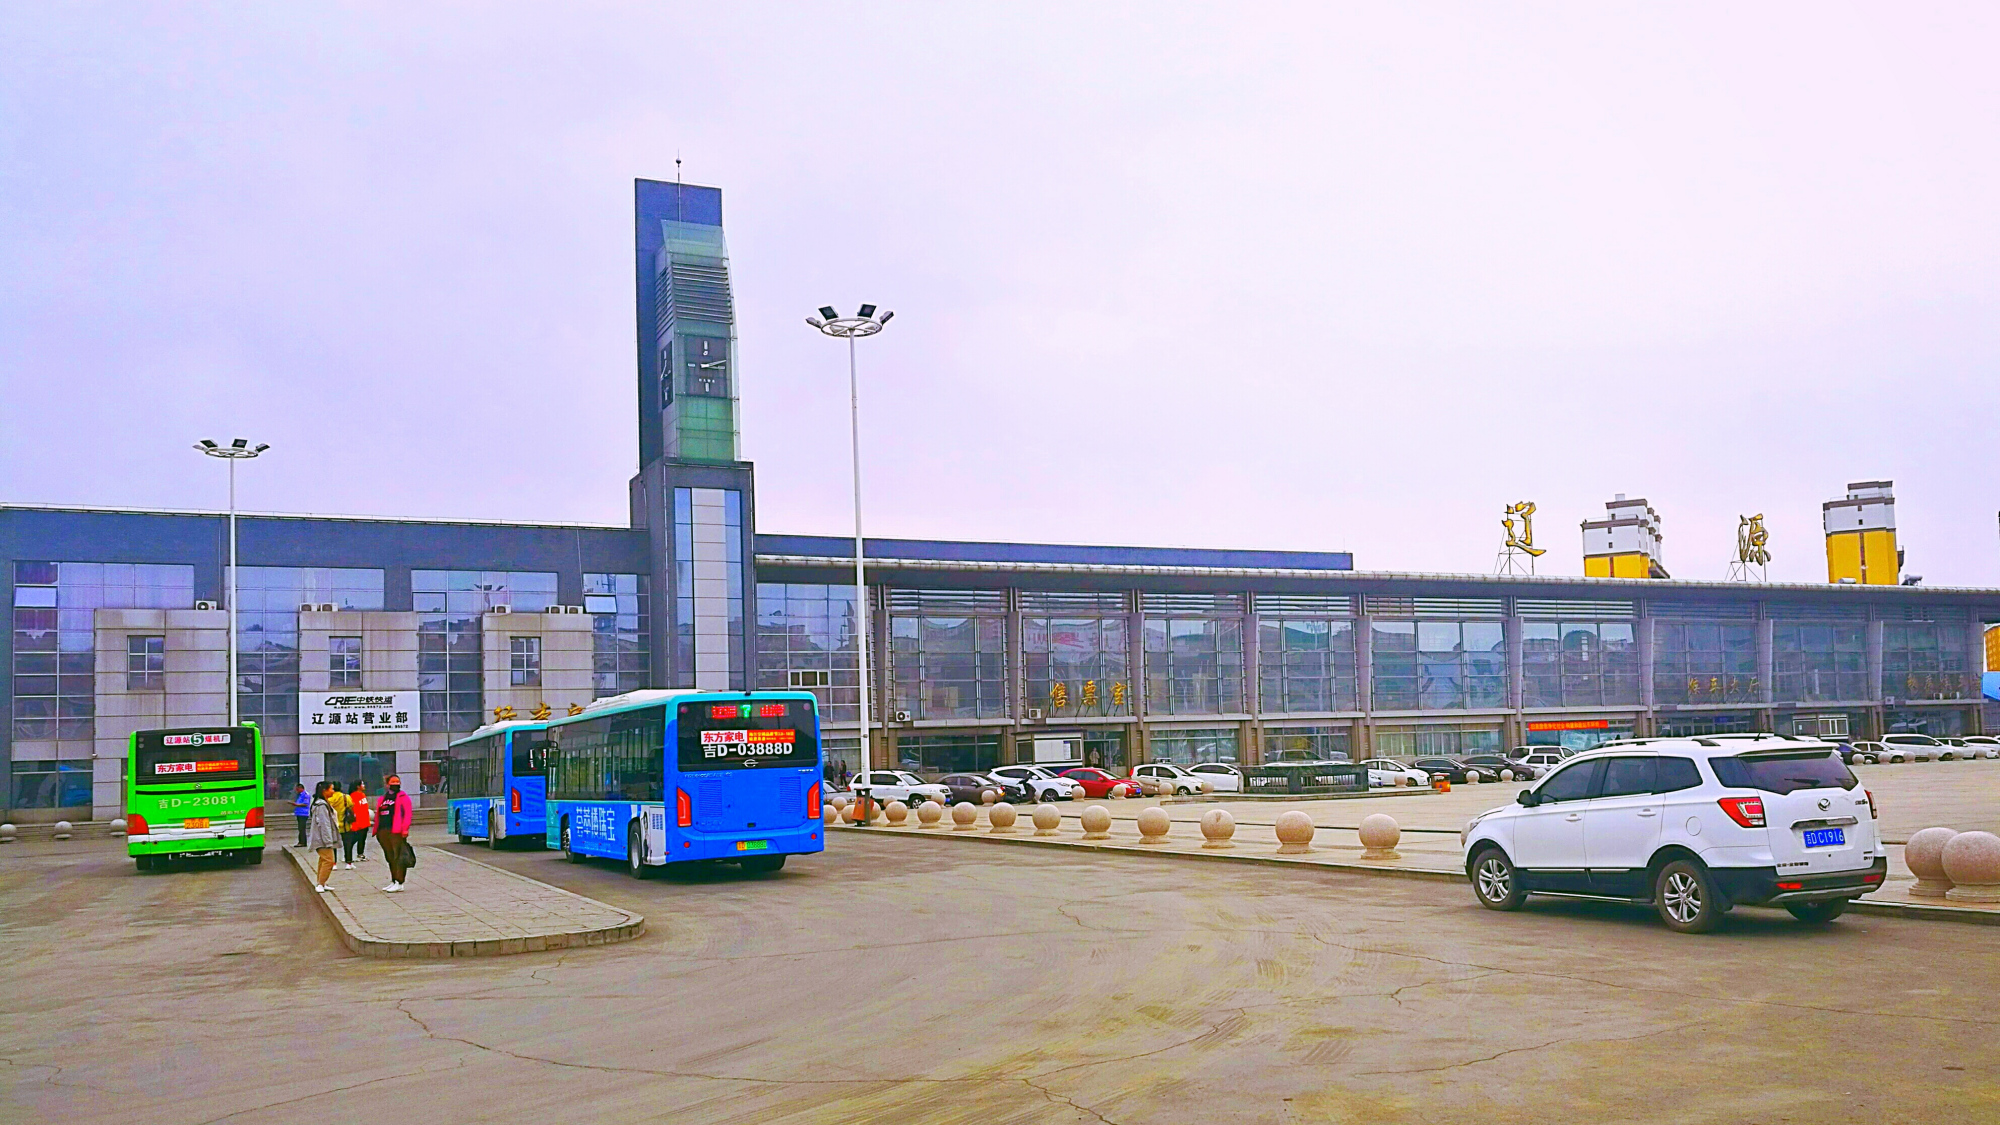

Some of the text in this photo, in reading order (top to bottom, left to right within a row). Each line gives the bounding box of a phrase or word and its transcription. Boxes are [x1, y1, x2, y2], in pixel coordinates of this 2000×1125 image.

[1050, 680, 1128, 707] 售票室
[311, 711, 408, 725] 辽源站营业部
[741, 704, 752, 718] 7
[166, 733, 229, 745] 辽源站 5 煤机厂
[703, 731, 745, 743] 东方家电
[703, 742, 793, 758] 吉D-03888D
[157, 763, 194, 773] 东方家电
[158, 795, 237, 809] 吉D-23081
